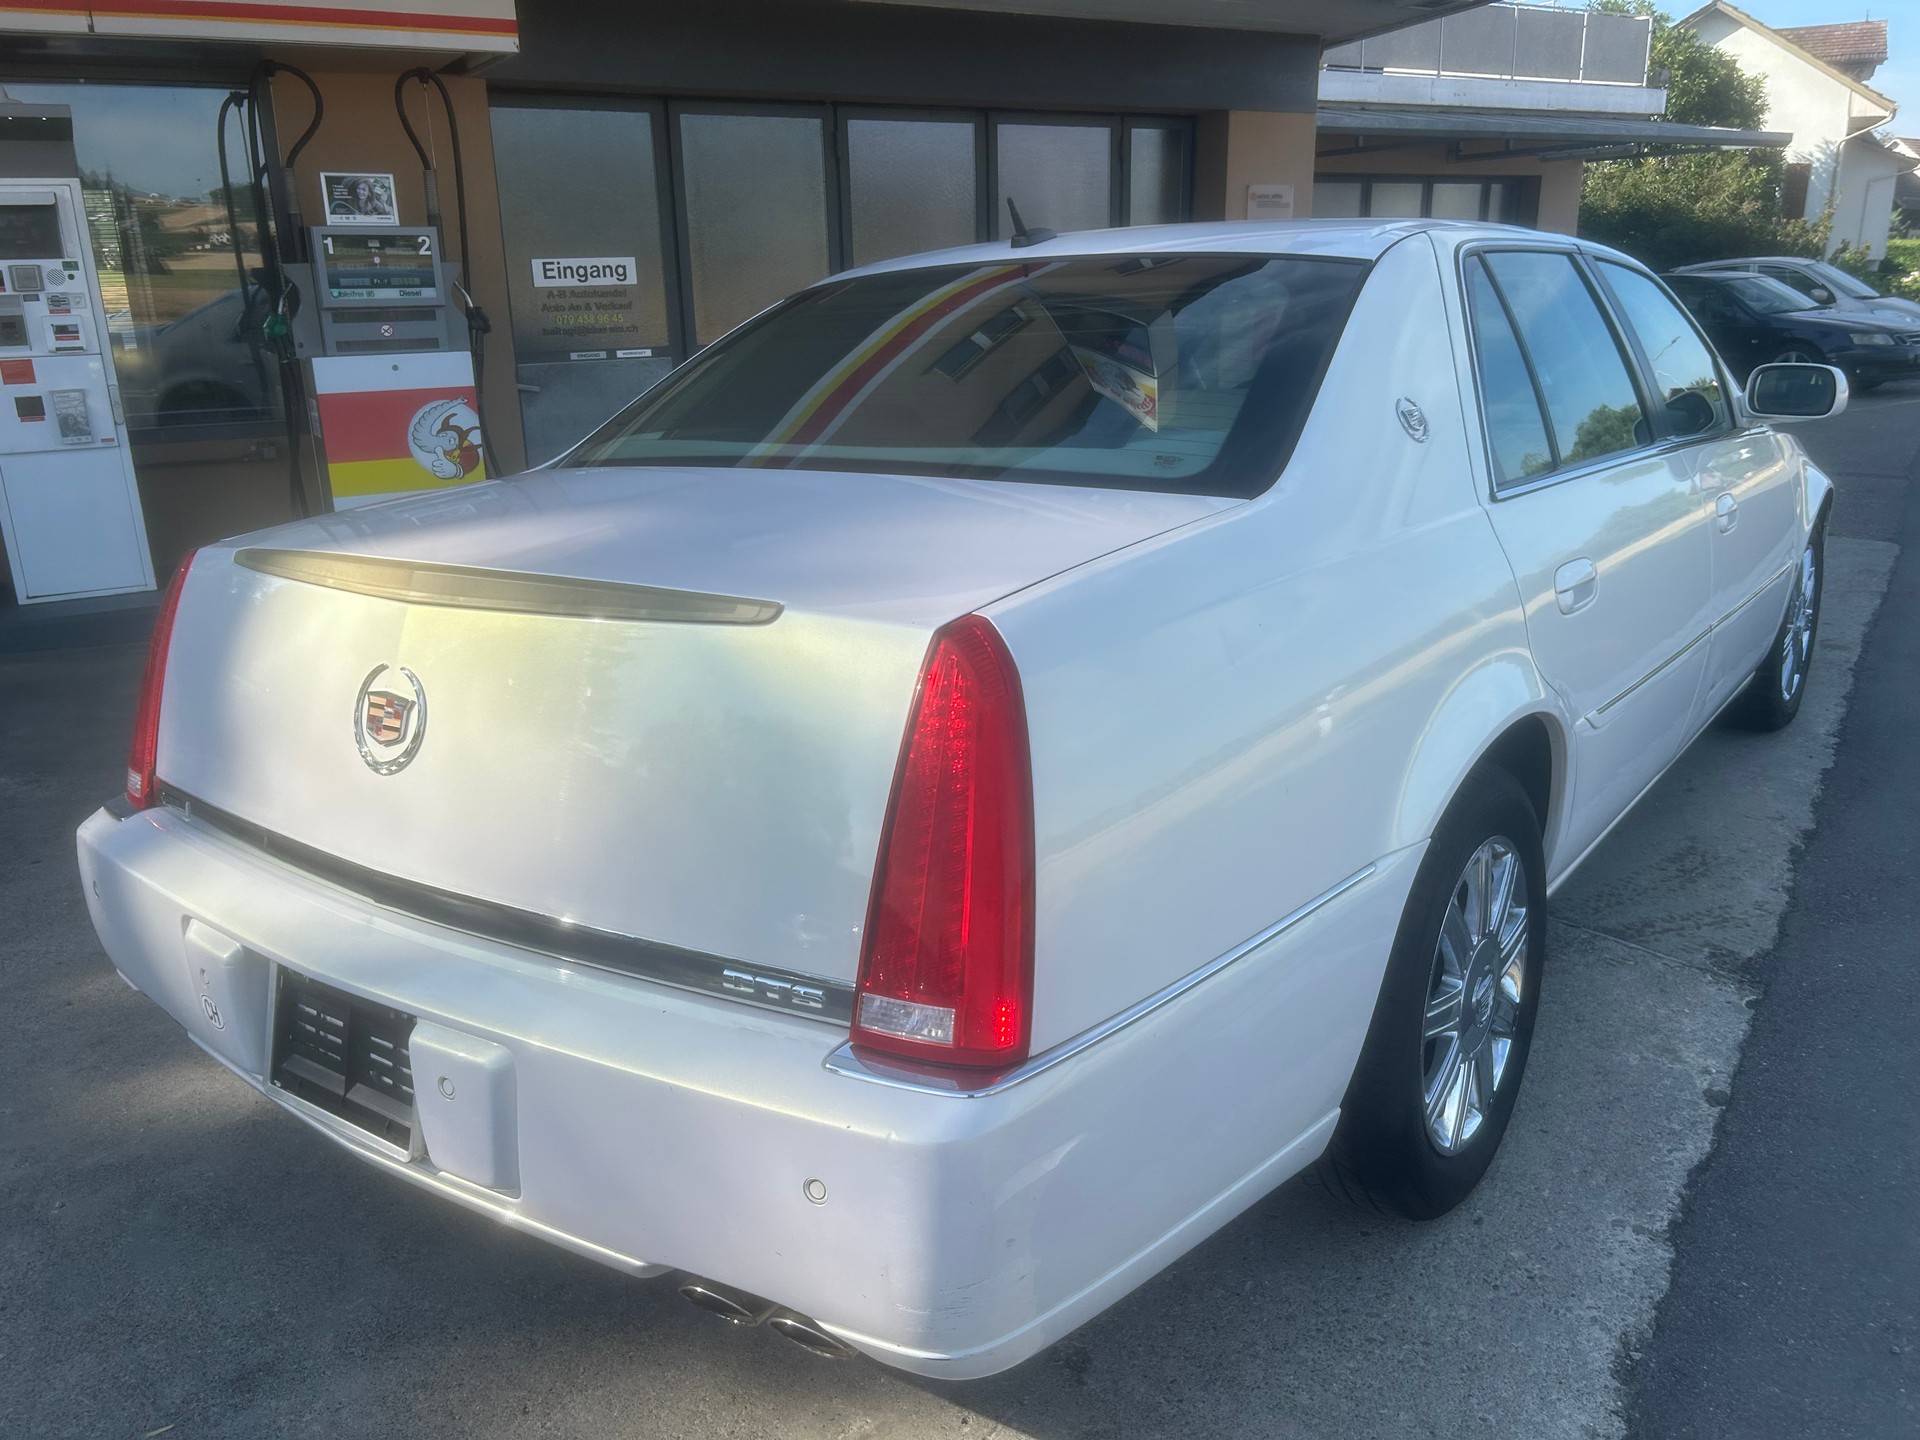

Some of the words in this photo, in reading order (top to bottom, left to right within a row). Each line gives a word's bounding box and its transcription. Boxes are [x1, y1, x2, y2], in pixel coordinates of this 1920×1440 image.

[323, 237, 334, 255] 1
[417, 236, 432, 255] 2
[542, 261, 627, 283] Eingang
[366, 290, 375, 298] 95
[399, 289, 422, 297] Diesel
[546, 289, 567, 299] A-B
[569, 288, 627, 299] Autohandel
[540, 303, 566, 313] Auto
[568, 303, 582, 312] An
[584, 302, 593, 311] &
[594, 301, 633, 311] Verkauf
[556, 315, 575, 325] 079
[577, 315, 595, 324] 438
[597, 314, 609, 324] 96
[612, 313, 624, 323] 45
[722, 969, 826, 1008] DTS
[203, 998, 222, 1027] CH
